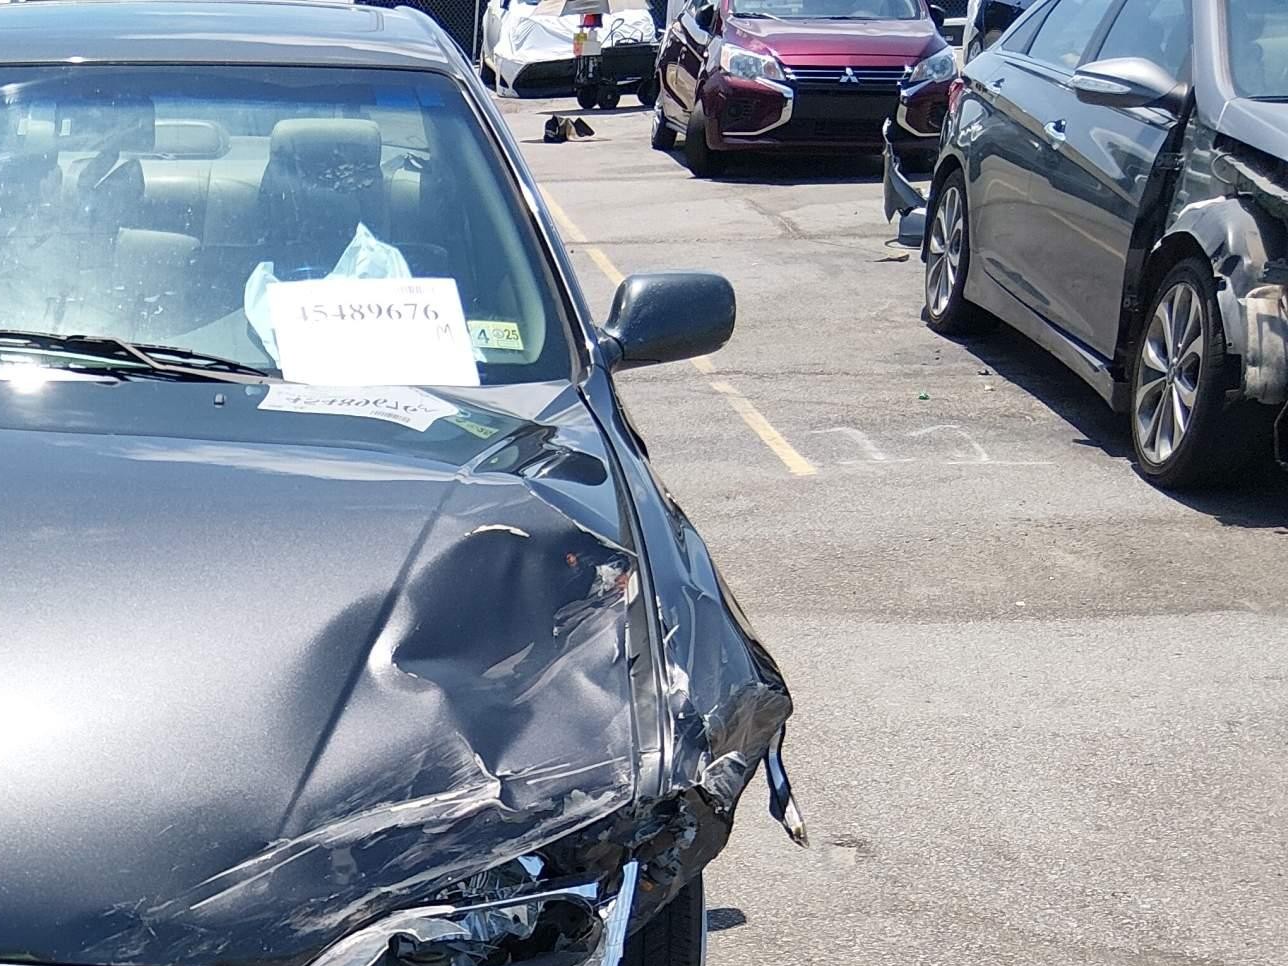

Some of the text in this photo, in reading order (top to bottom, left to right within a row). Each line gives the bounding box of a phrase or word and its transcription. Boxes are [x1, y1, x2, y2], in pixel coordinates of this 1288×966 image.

[298, 303, 440, 322] 45489676
[477, 328, 519, 344] 4 25
